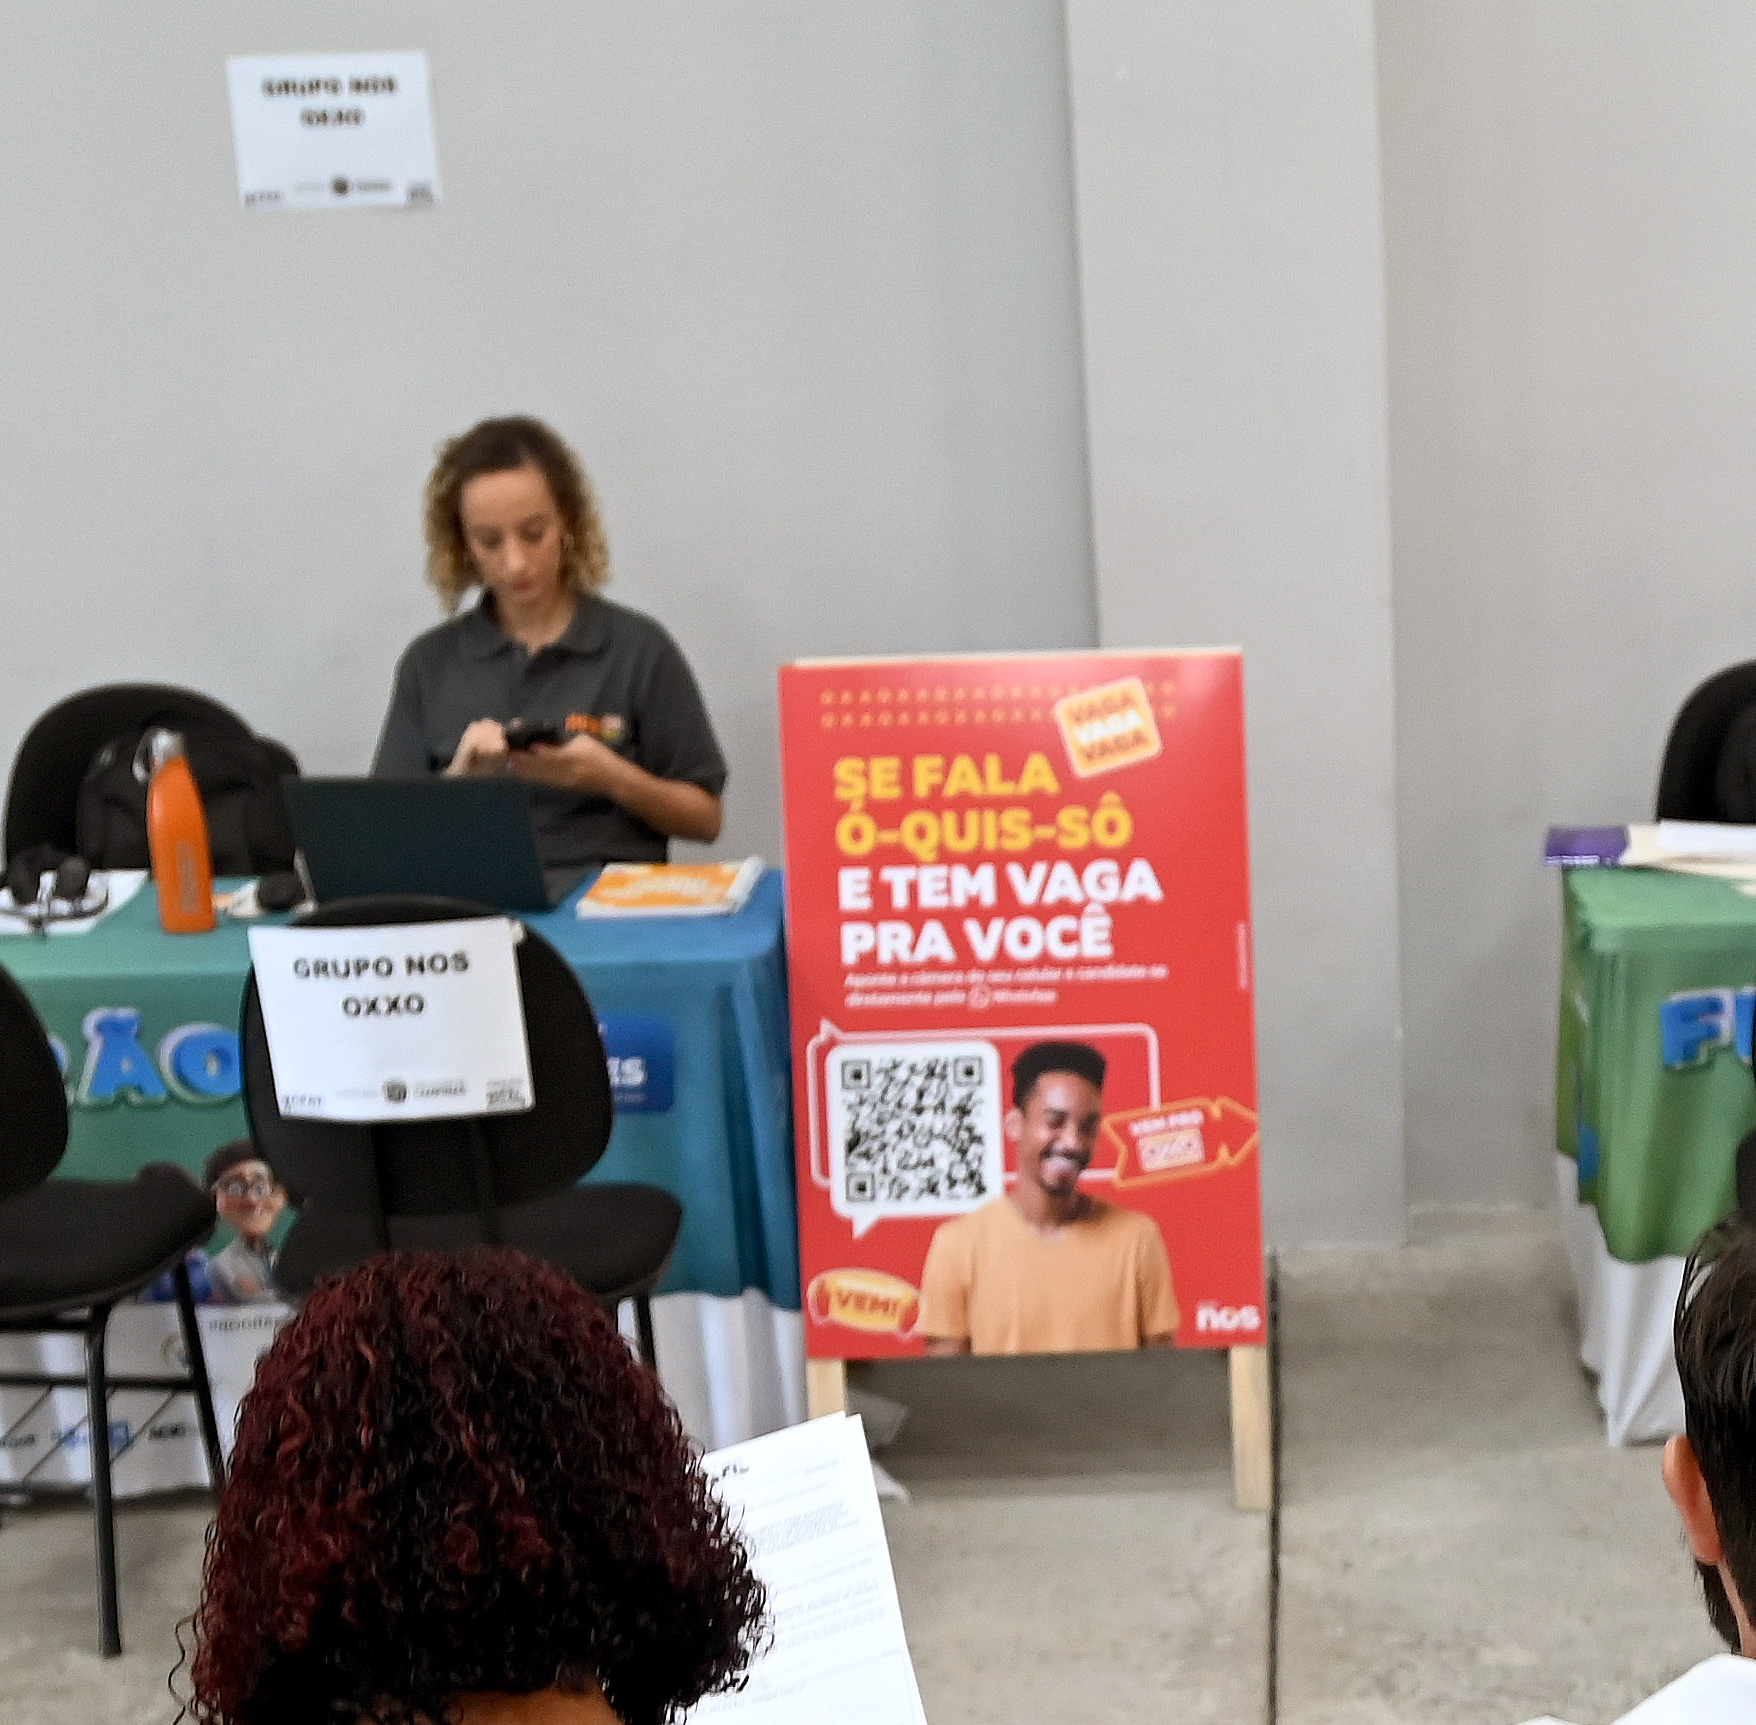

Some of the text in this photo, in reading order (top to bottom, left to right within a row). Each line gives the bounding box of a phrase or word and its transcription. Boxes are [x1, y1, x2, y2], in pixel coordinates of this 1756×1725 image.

[834, 751, 1061, 800] SE FALA
[837, 857, 1165, 912] E TEM VAGA
[840, 901, 1114, 967] PRA VOCÊ
[293, 950, 469, 979] GRUPO NOS
[342, 993, 425, 1017] OXXO
[836, 1288, 898, 1318] VEM!
